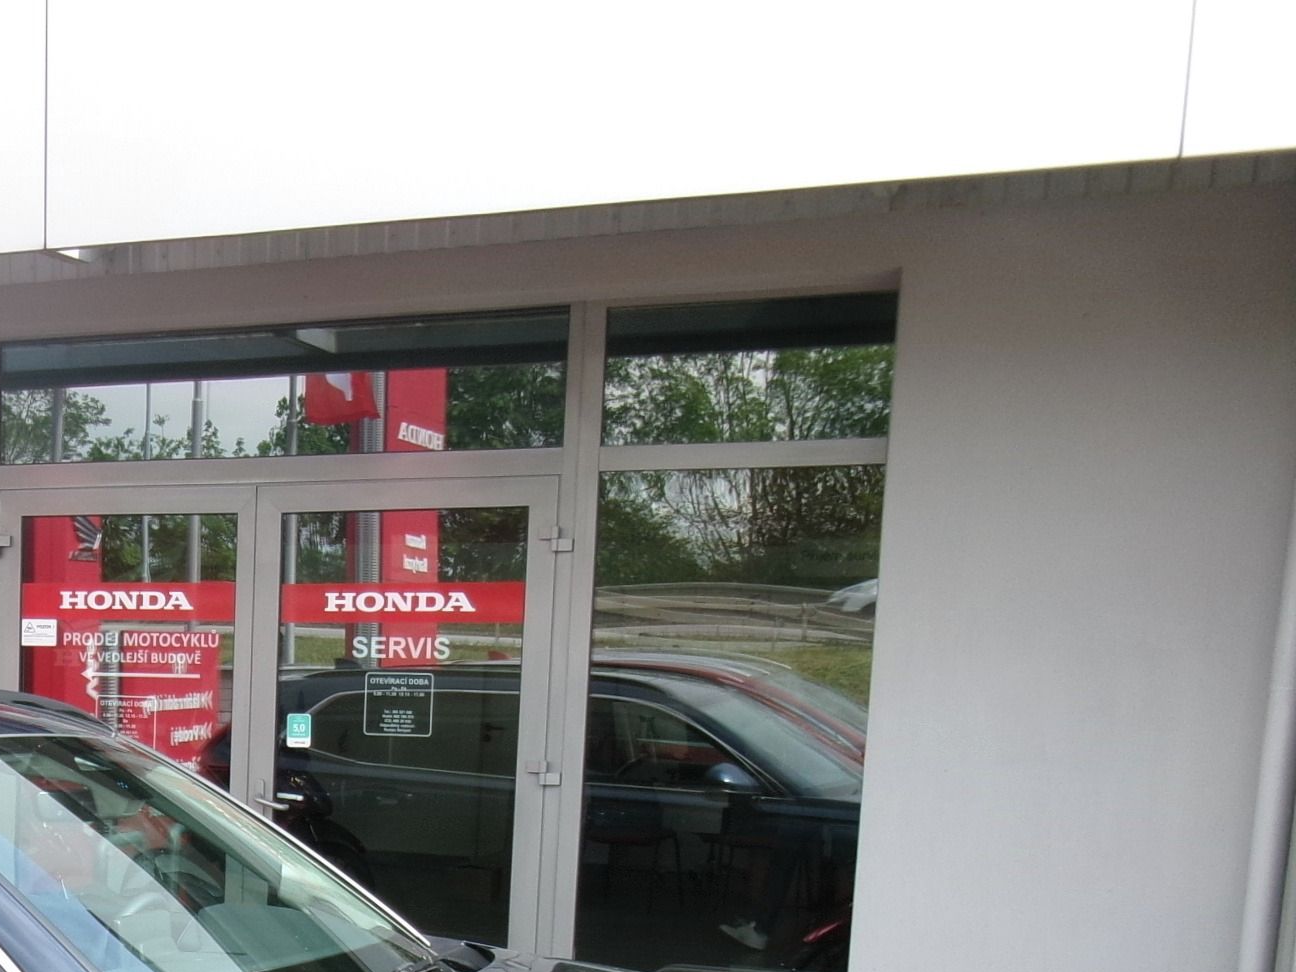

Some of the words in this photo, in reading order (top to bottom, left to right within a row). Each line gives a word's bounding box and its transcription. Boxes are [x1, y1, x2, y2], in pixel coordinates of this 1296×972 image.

[59, 591, 194, 610] HONDA
[324, 592, 476, 612] HONDA
[63, 632, 119, 647] PRODEJ
[123, 630, 220, 648] MOTOCYKLŮ
[351, 636, 451, 660] SERVIS
[79, 651, 94, 664] VE
[97, 650, 148, 664] VEDLEJŠÍ
[150, 650, 202, 665] BUDOVĚ
